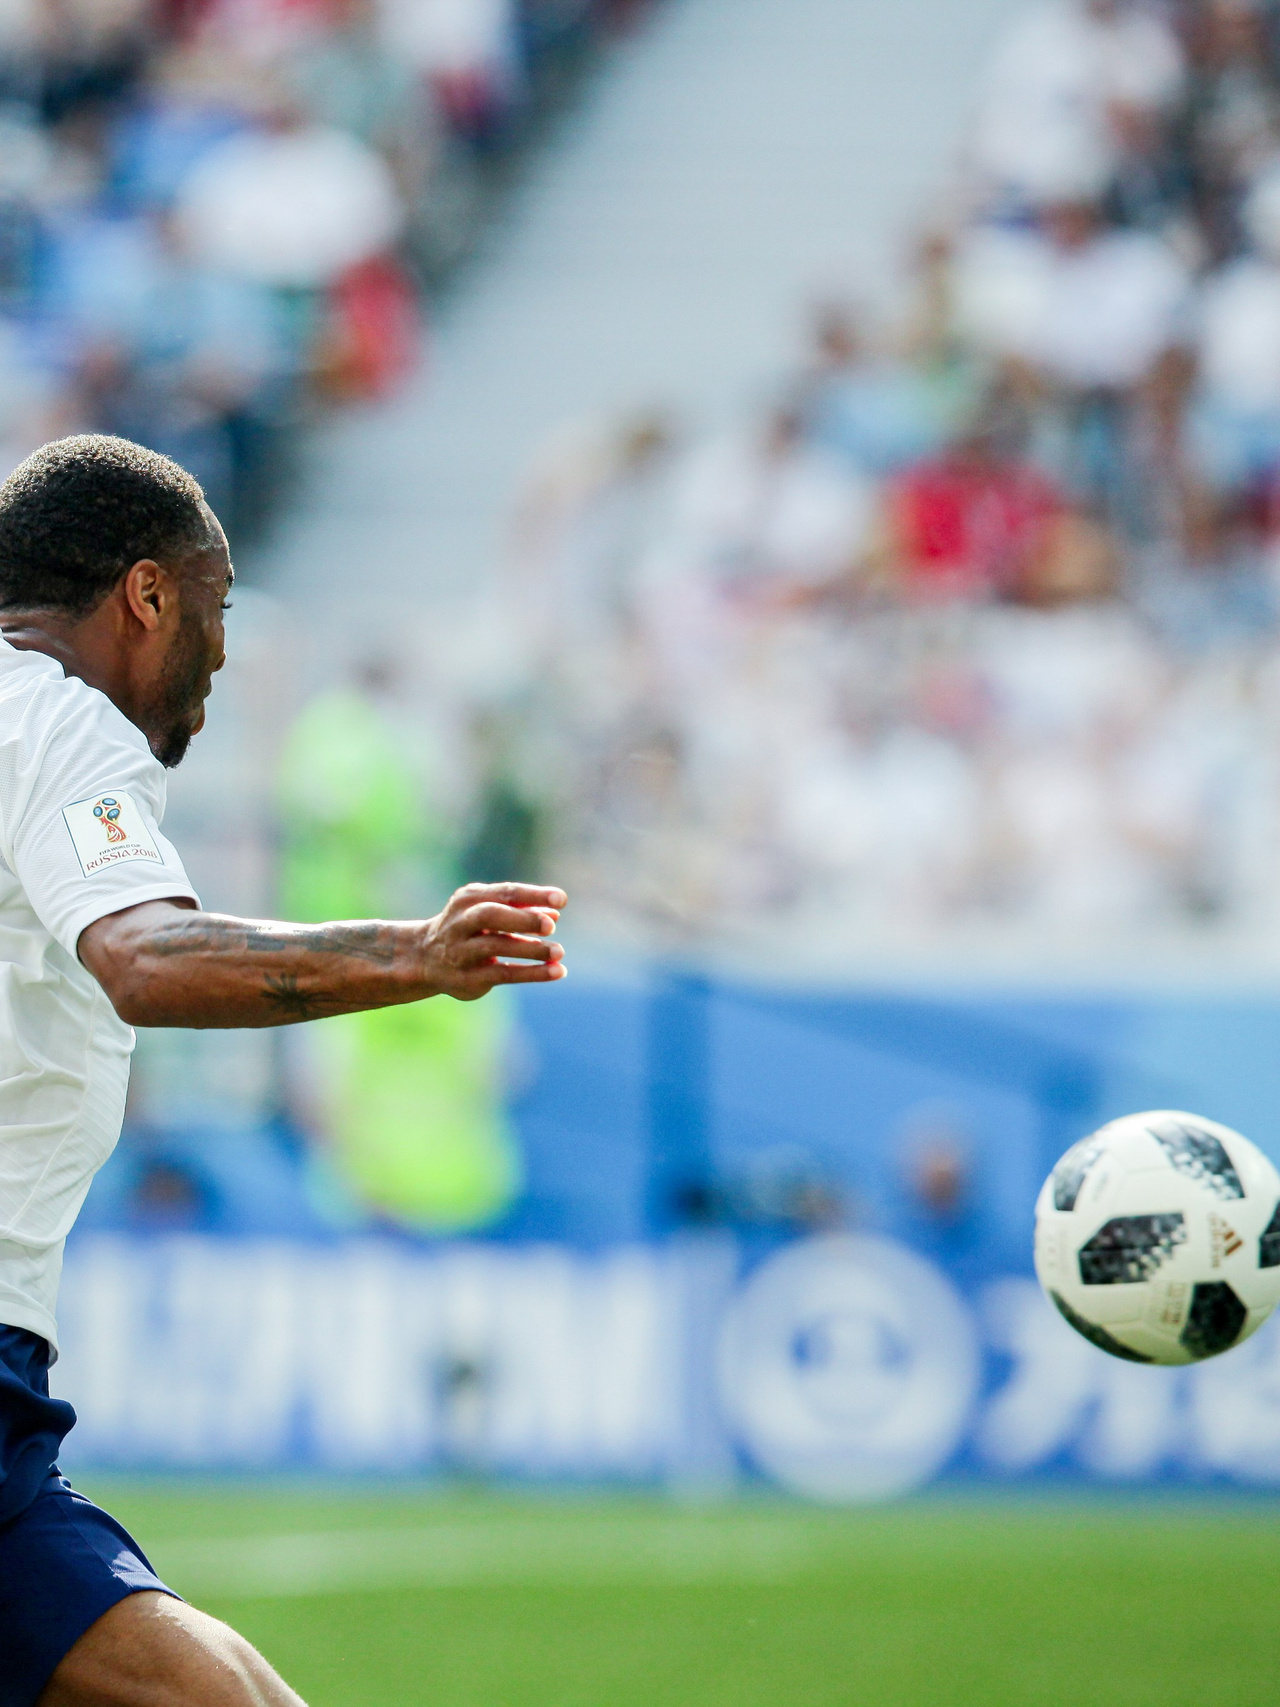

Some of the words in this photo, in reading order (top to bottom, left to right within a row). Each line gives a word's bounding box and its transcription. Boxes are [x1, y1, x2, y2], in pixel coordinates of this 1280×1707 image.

[111, 843, 130, 851] WORLD
[86, 849, 131, 871] RUSSIA
[132, 848, 158, 859] 2018
